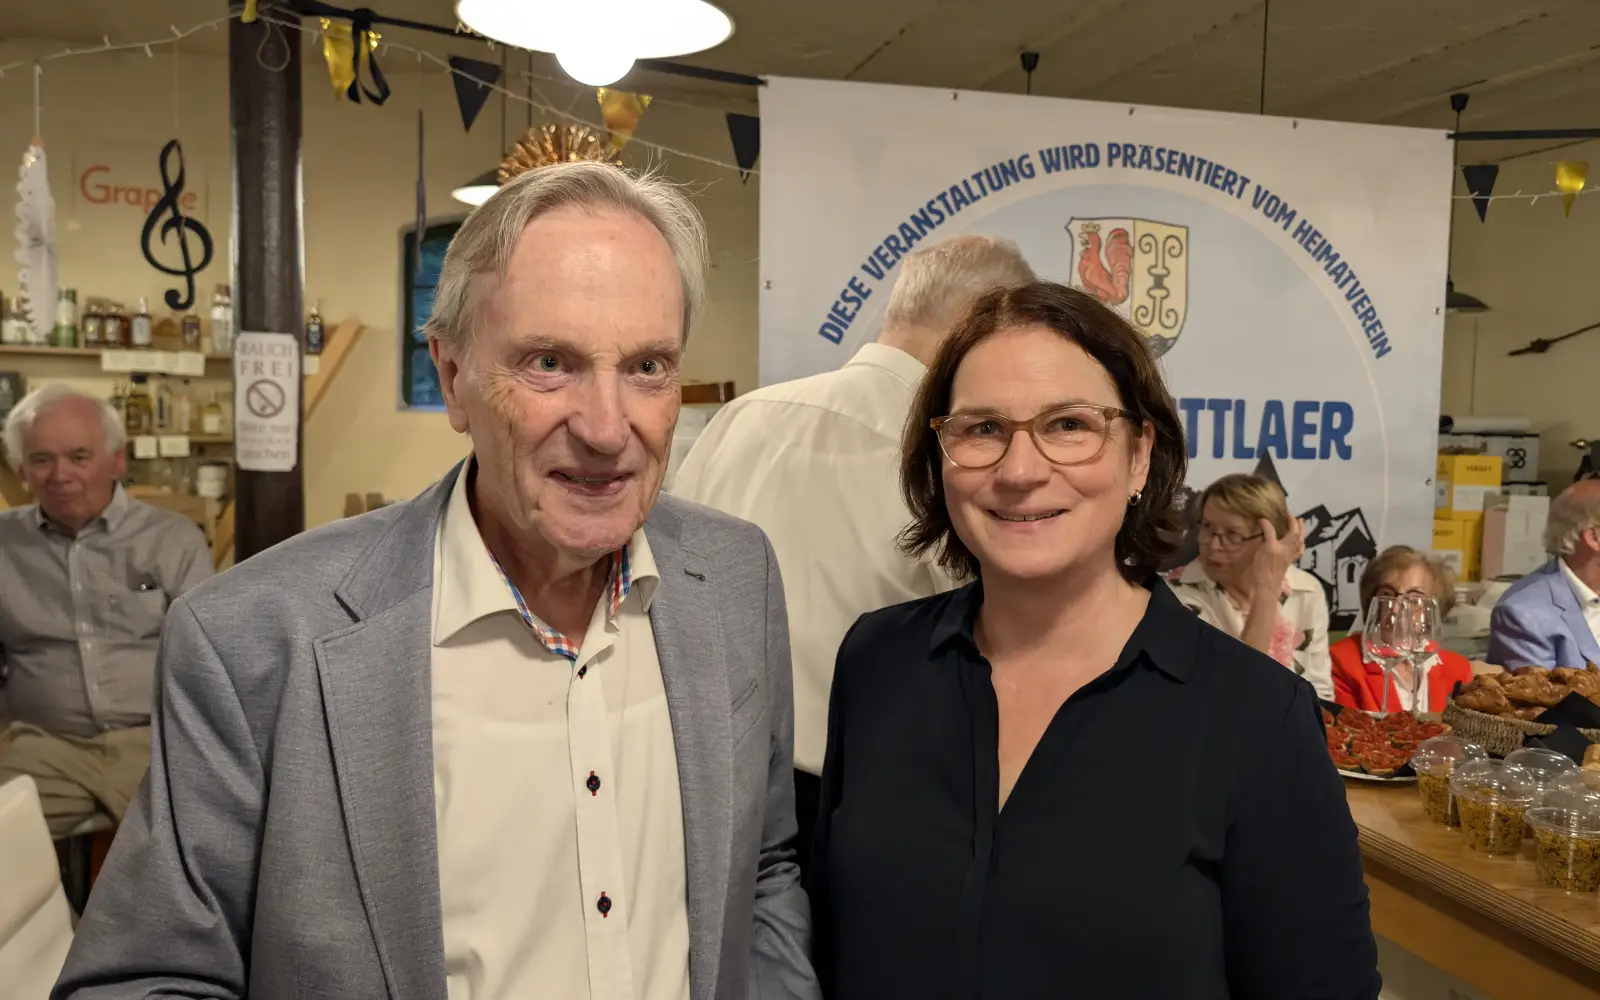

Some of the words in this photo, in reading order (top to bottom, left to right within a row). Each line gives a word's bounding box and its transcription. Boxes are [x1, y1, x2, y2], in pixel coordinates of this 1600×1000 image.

[80, 164, 198, 216] Grape
[818, 276, 872, 345] DIESE
[861, 153, 1036, 281] VERANSTALTUNG
[1038, 143, 1100, 174] WIRD
[1107, 142, 1250, 200] PRÄSENTIERT
[1251, 184, 1297, 231] VOM
[1292, 219, 1392, 359] HEIMATVEREIN
[240, 360, 292, 377] FREI
[1172, 397, 1354, 461] TTLAER
